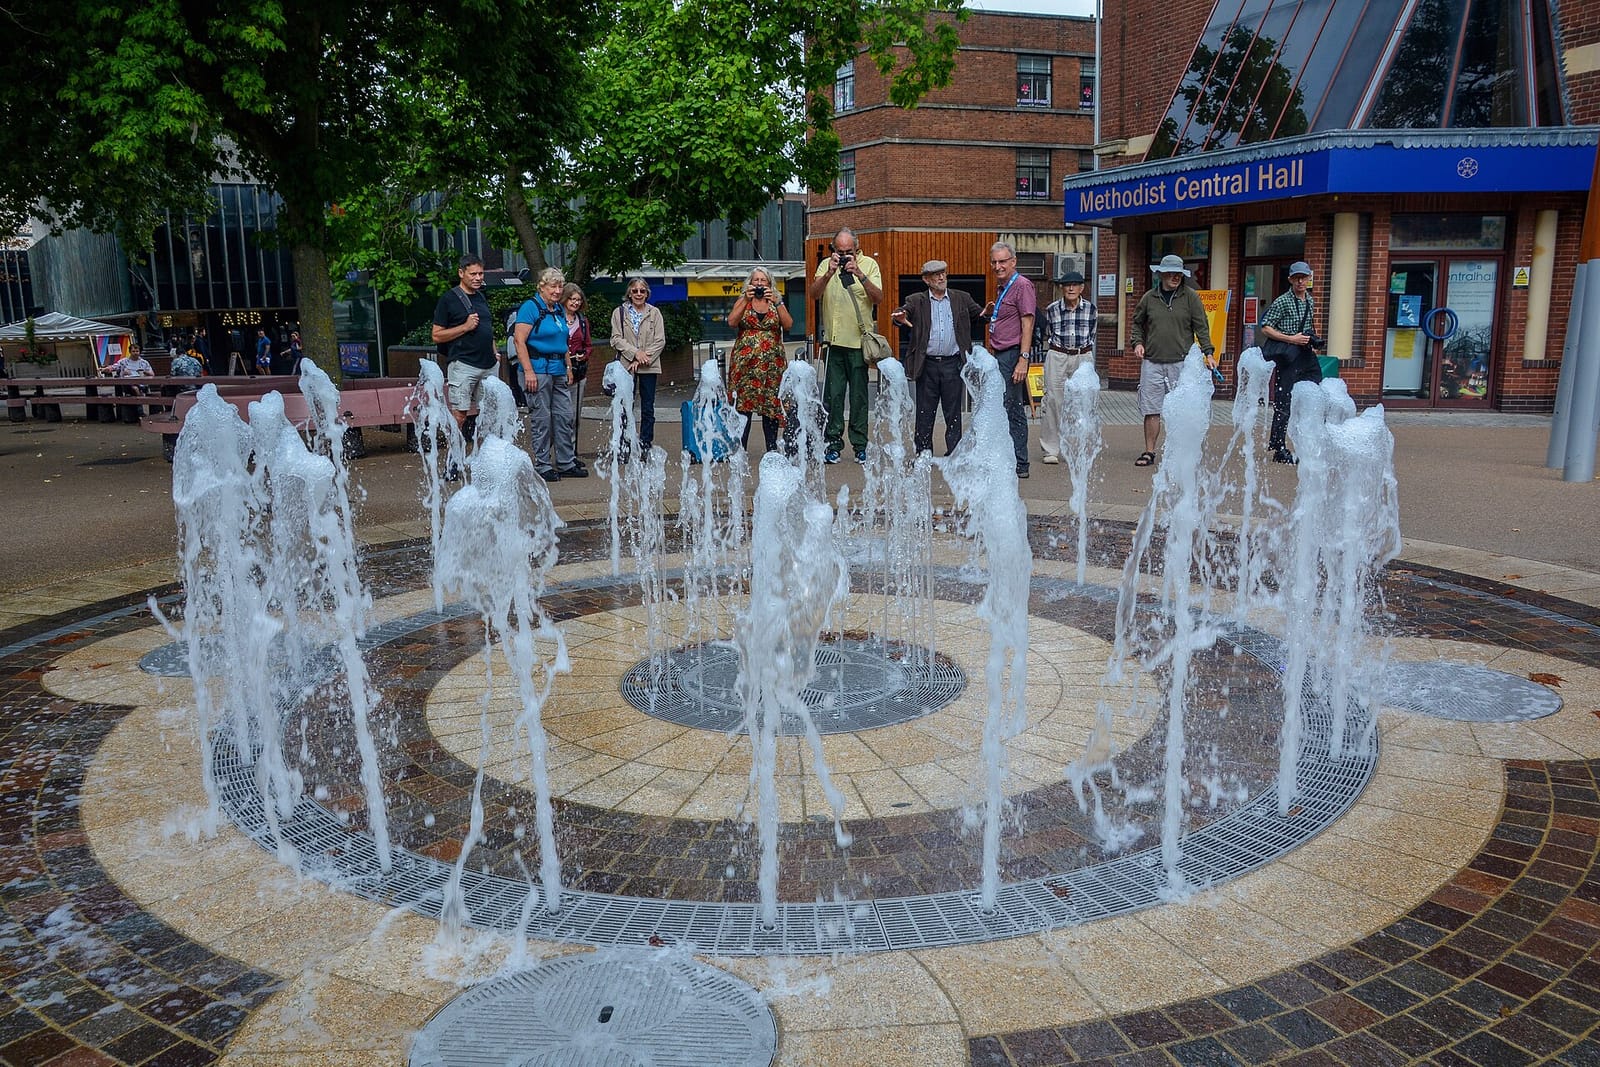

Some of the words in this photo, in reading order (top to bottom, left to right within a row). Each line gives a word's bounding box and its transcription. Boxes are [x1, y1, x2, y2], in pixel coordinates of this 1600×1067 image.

[1080, 181, 1167, 213] Methodist
[1174, 167, 1250, 201] Central
[1258, 159, 1304, 191] Hall
[1448, 272, 1497, 281] ntralhall
